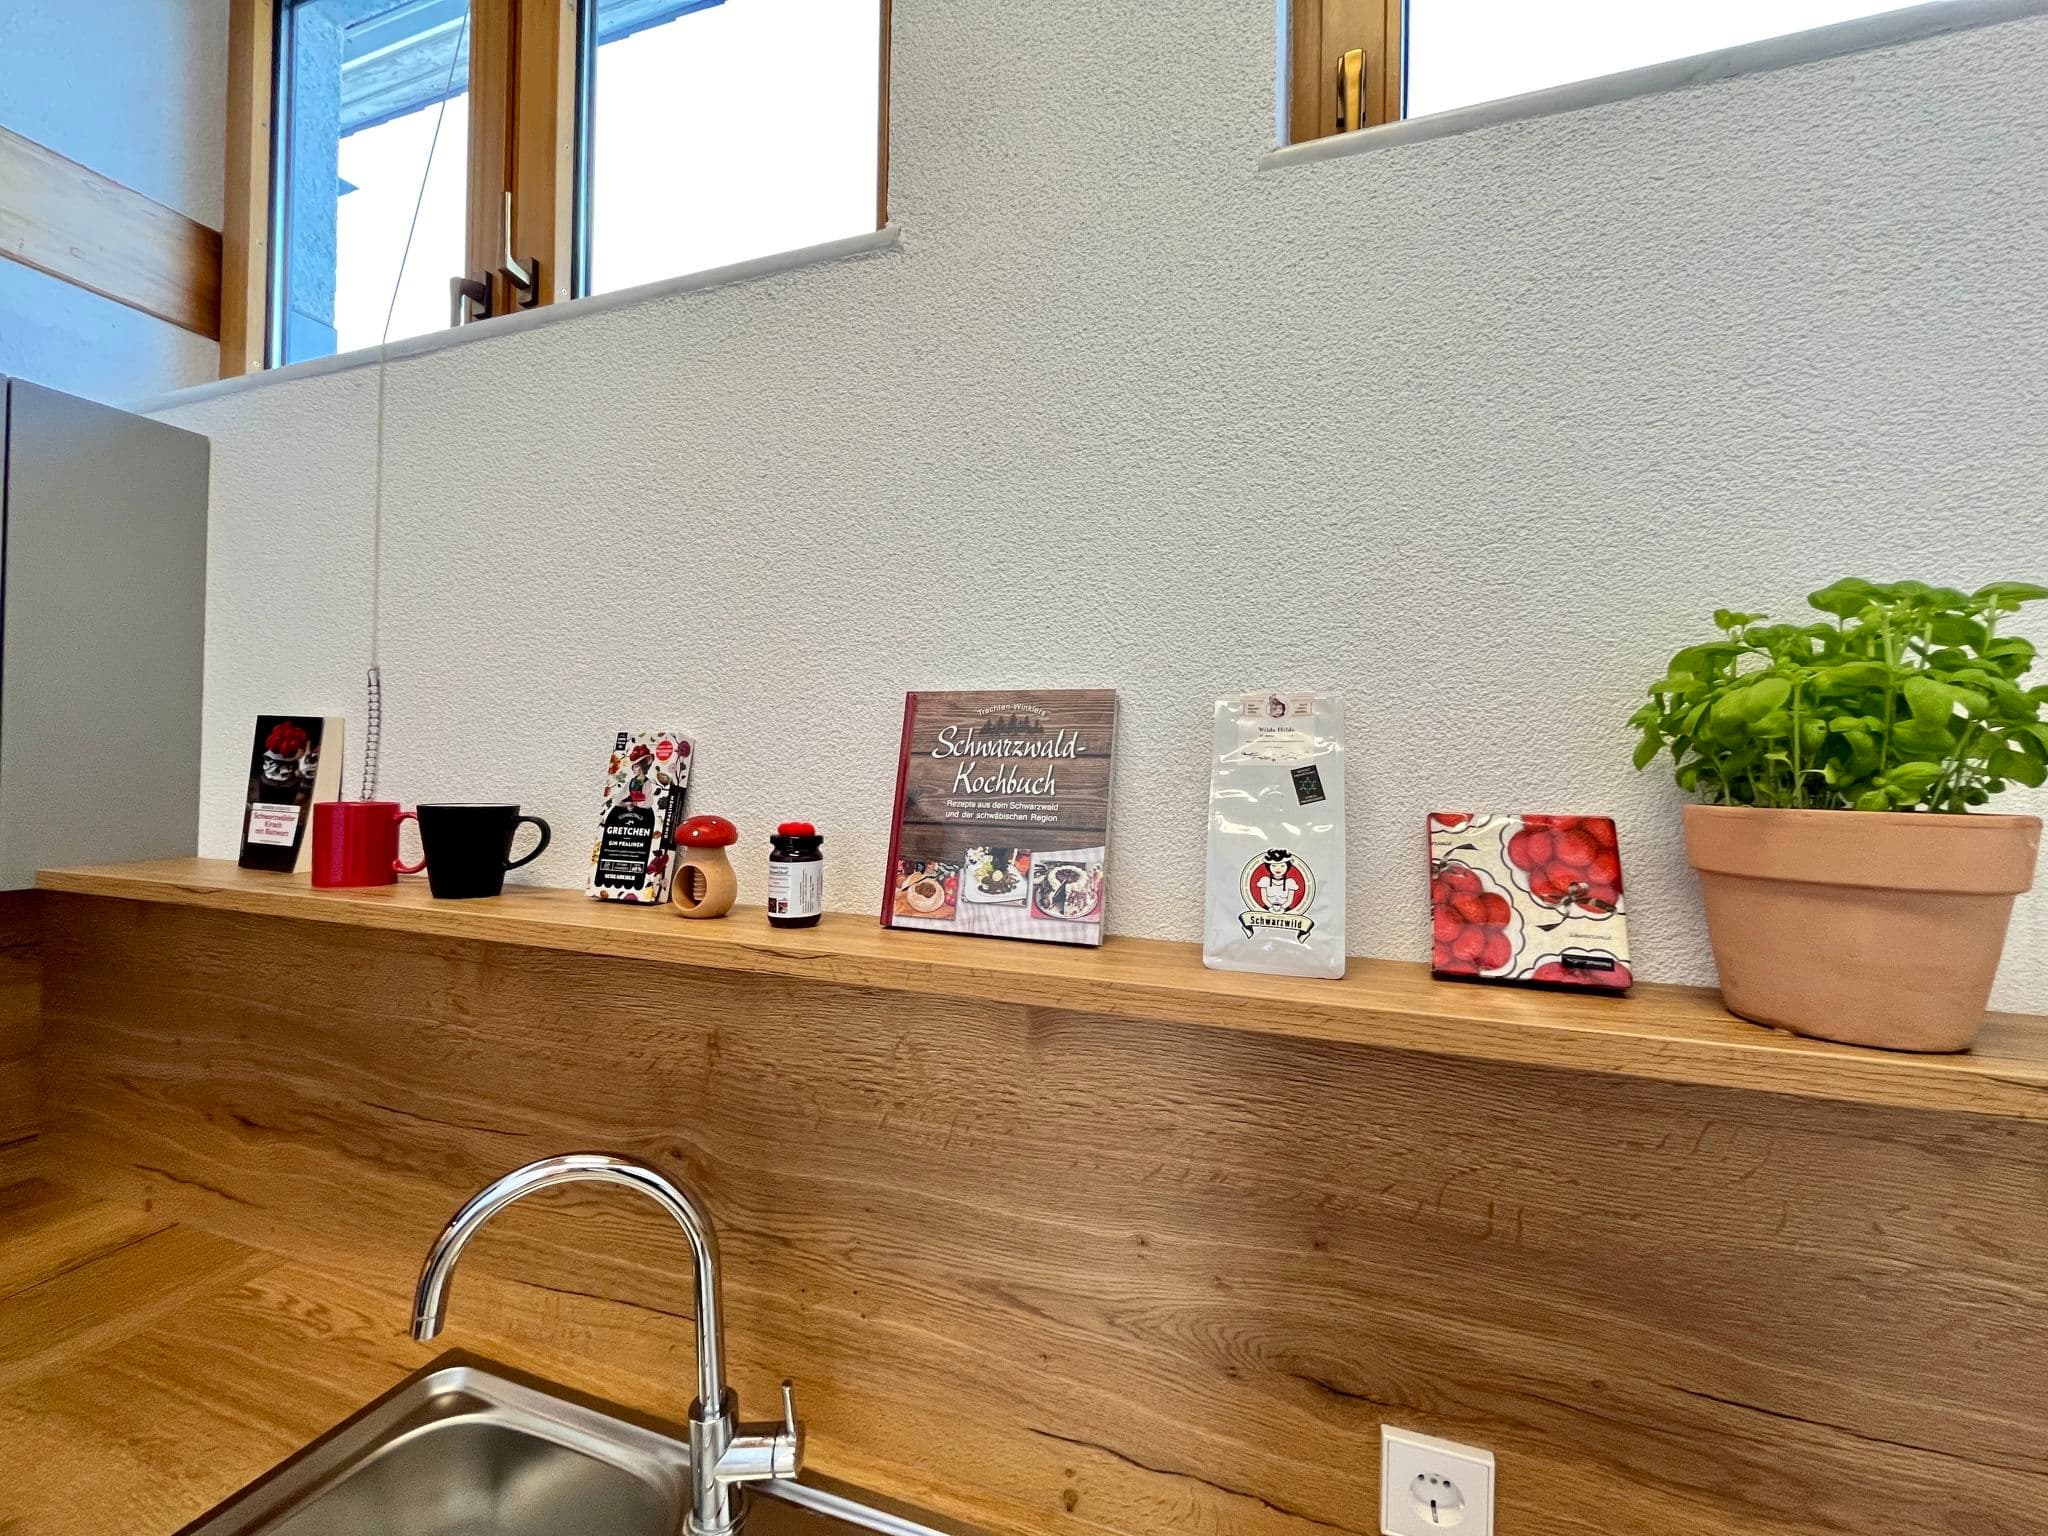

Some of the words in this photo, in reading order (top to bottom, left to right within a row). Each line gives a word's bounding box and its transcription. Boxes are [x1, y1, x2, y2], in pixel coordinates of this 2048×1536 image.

[931, 725, 1087, 759] Schwarzwald-
[952, 761, 1057, 796] Kochbuch
[946, 799, 976, 809] Rezepte
[992, 801, 1009, 810] dem
[1009, 801, 1059, 811] Schwarzwald
[945, 811, 960, 819] und
[961, 811, 973, 819] der
[976, 811, 1028, 821] schwäbischen
[1030, 813, 1058, 823] Region
[606, 826, 651, 837] GRETCHEN
[1250, 915, 1303, 929] Schwarzwild
